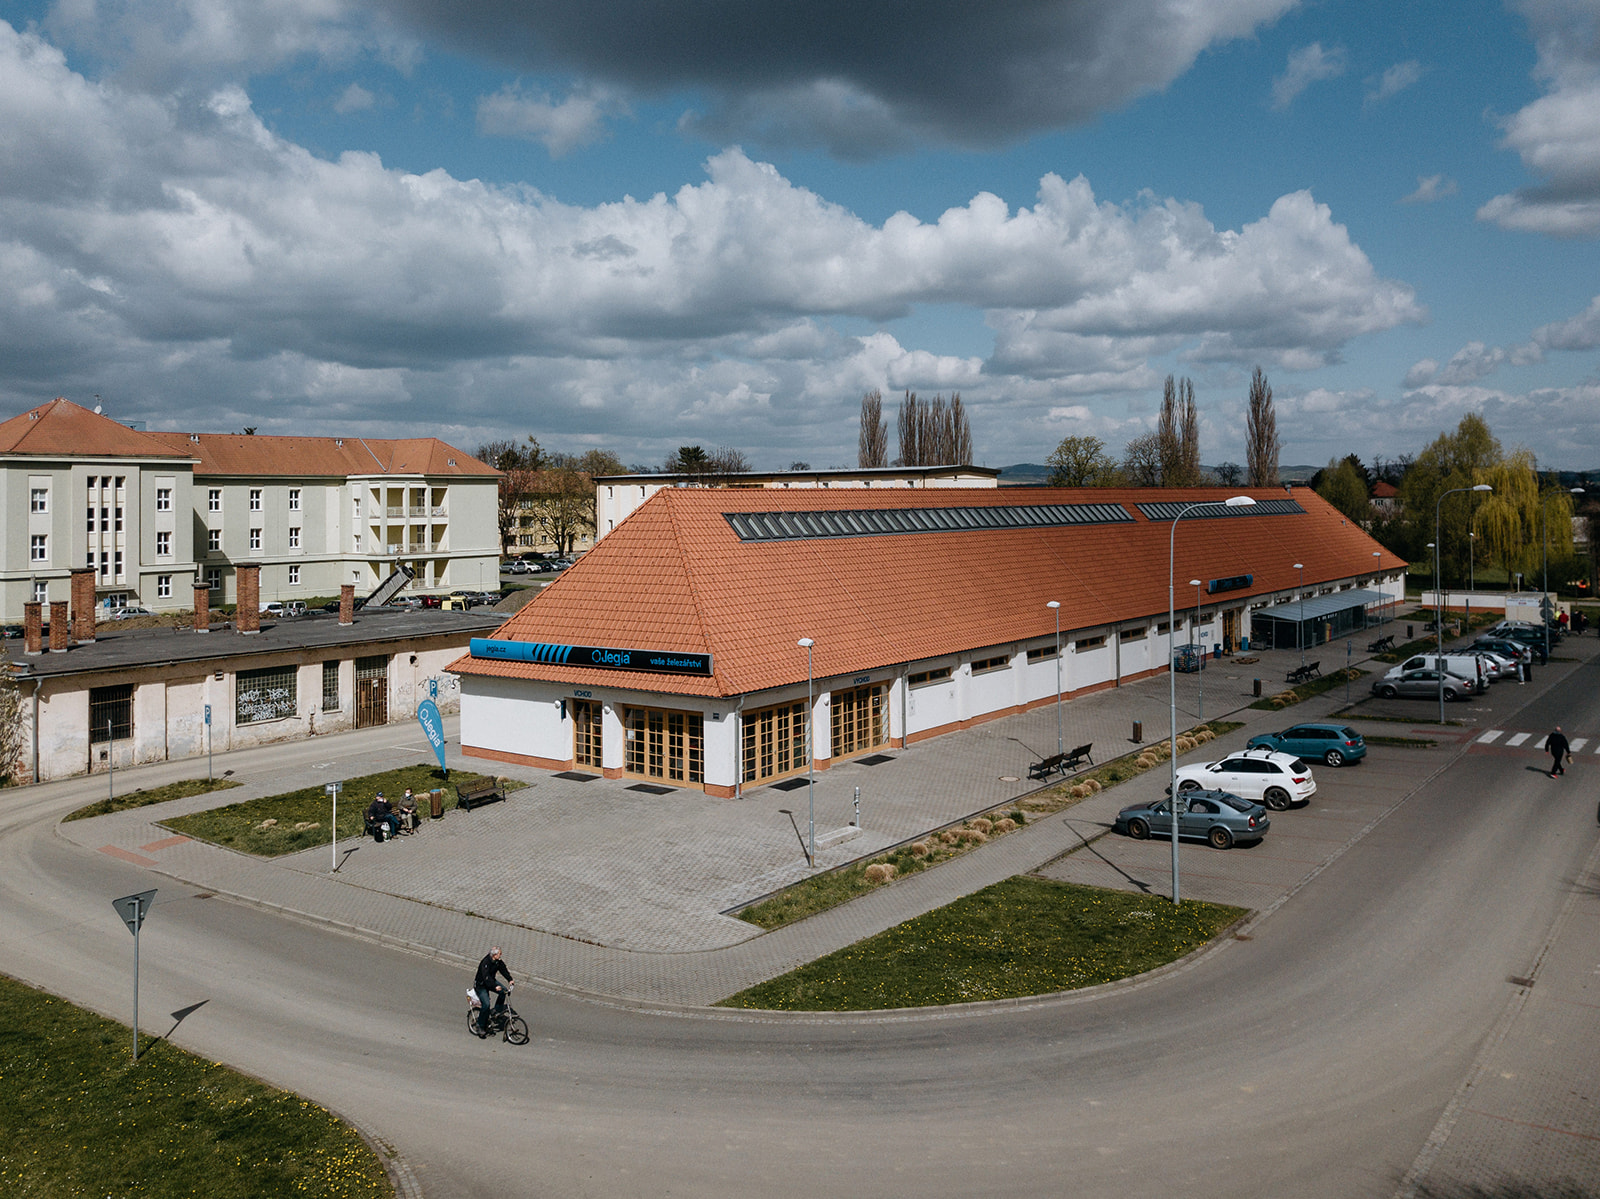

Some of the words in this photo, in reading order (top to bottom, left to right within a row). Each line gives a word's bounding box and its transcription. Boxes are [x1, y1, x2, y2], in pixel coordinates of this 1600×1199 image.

[601, 649, 631, 666] Jegla
[650, 657, 665, 666] vaše
[431, 682, 437, 692] P
[424, 719, 441, 747] Jegla
